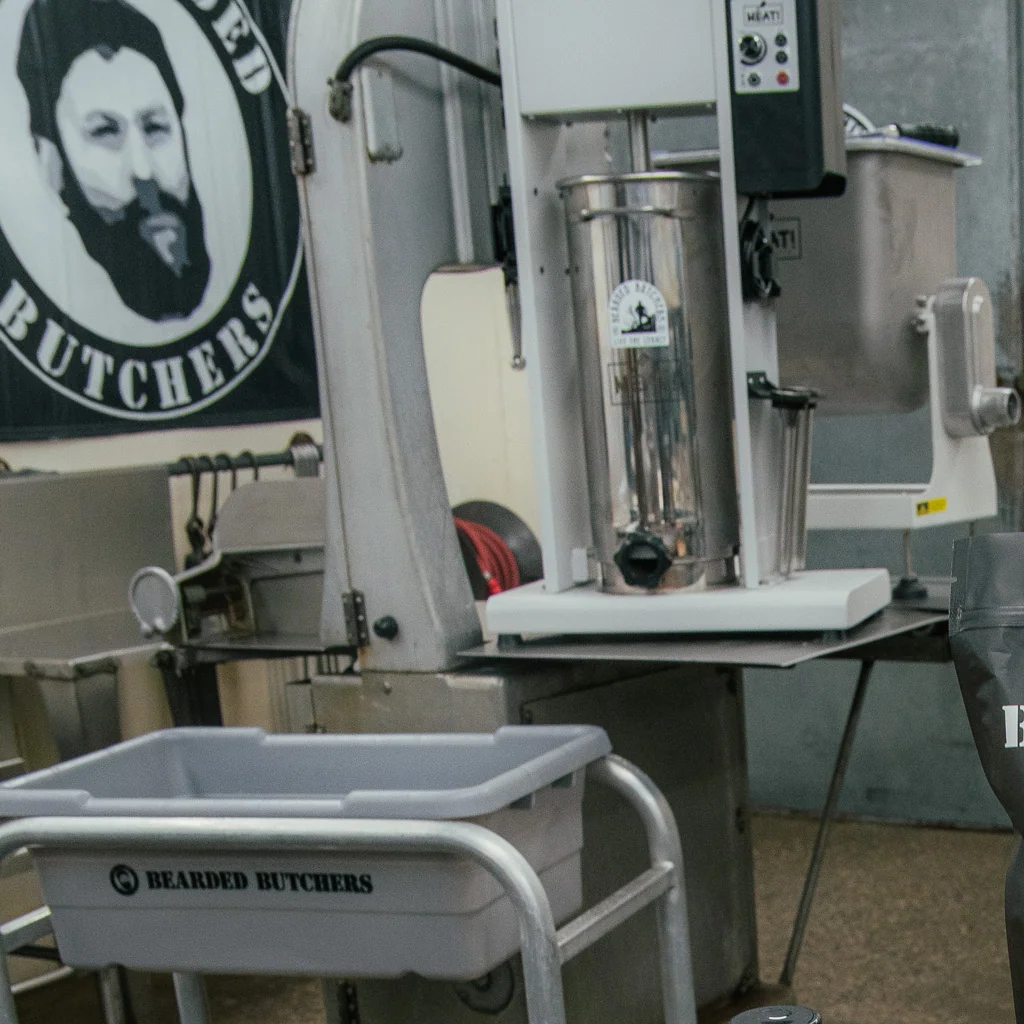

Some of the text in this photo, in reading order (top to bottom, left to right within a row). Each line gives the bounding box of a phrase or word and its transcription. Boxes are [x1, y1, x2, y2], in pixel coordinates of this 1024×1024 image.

[0, 279, 275, 410] BUTCHERS
[146, 870, 374, 895] BEARDED BUTCHERS
